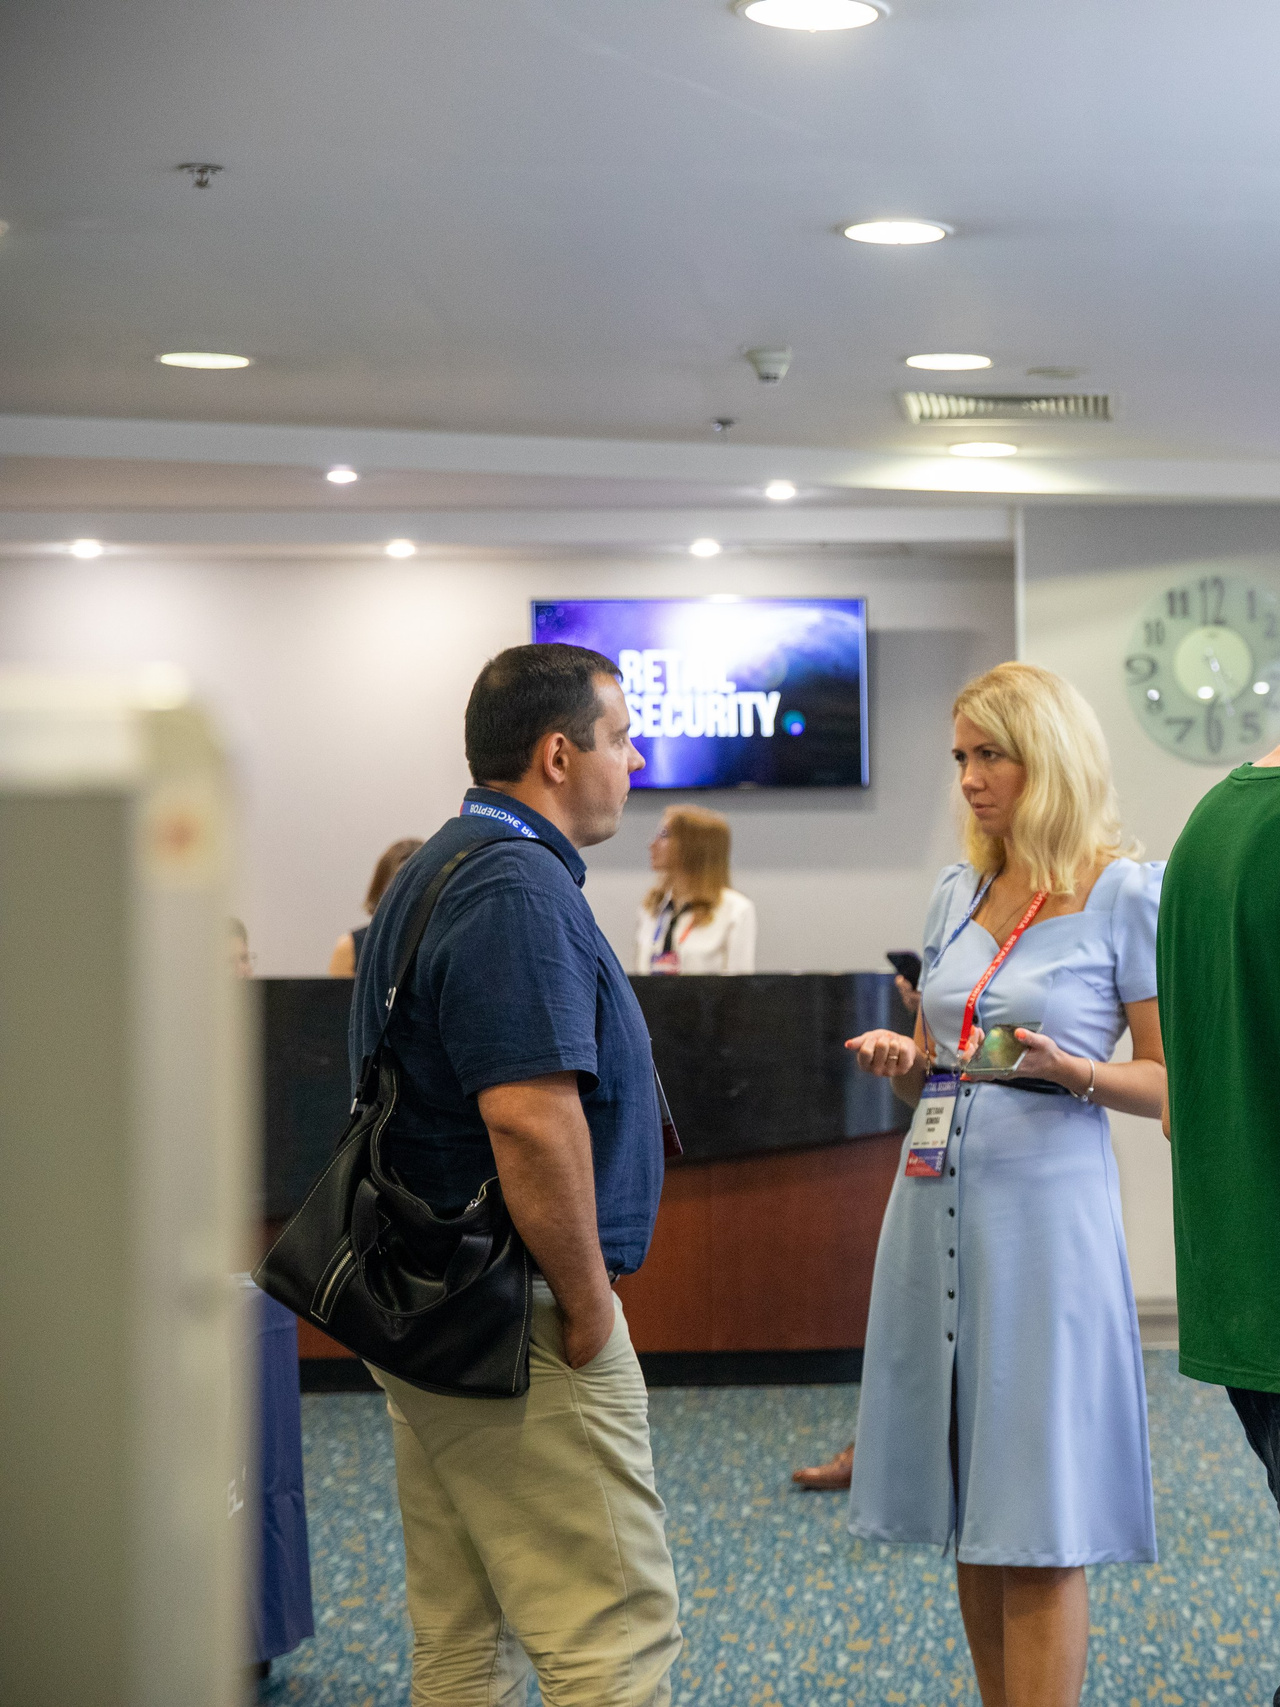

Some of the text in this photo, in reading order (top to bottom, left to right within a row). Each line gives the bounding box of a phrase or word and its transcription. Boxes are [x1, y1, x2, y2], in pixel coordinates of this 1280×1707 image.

[1167, 589, 1190, 619] 11
[1199, 576, 1227, 626] 12
[1246, 589, 1258, 621] 1
[628, 691, 782, 738] SECURITY
[1165, 716, 1195, 743] 7
[1239, 711, 1262, 743] 5
[470, 804, 521, 828] ЭКСПЕРТОВ
[994, 934, 1017, 964] RETAIL
[967, 966, 996, 1009] SECURITY
